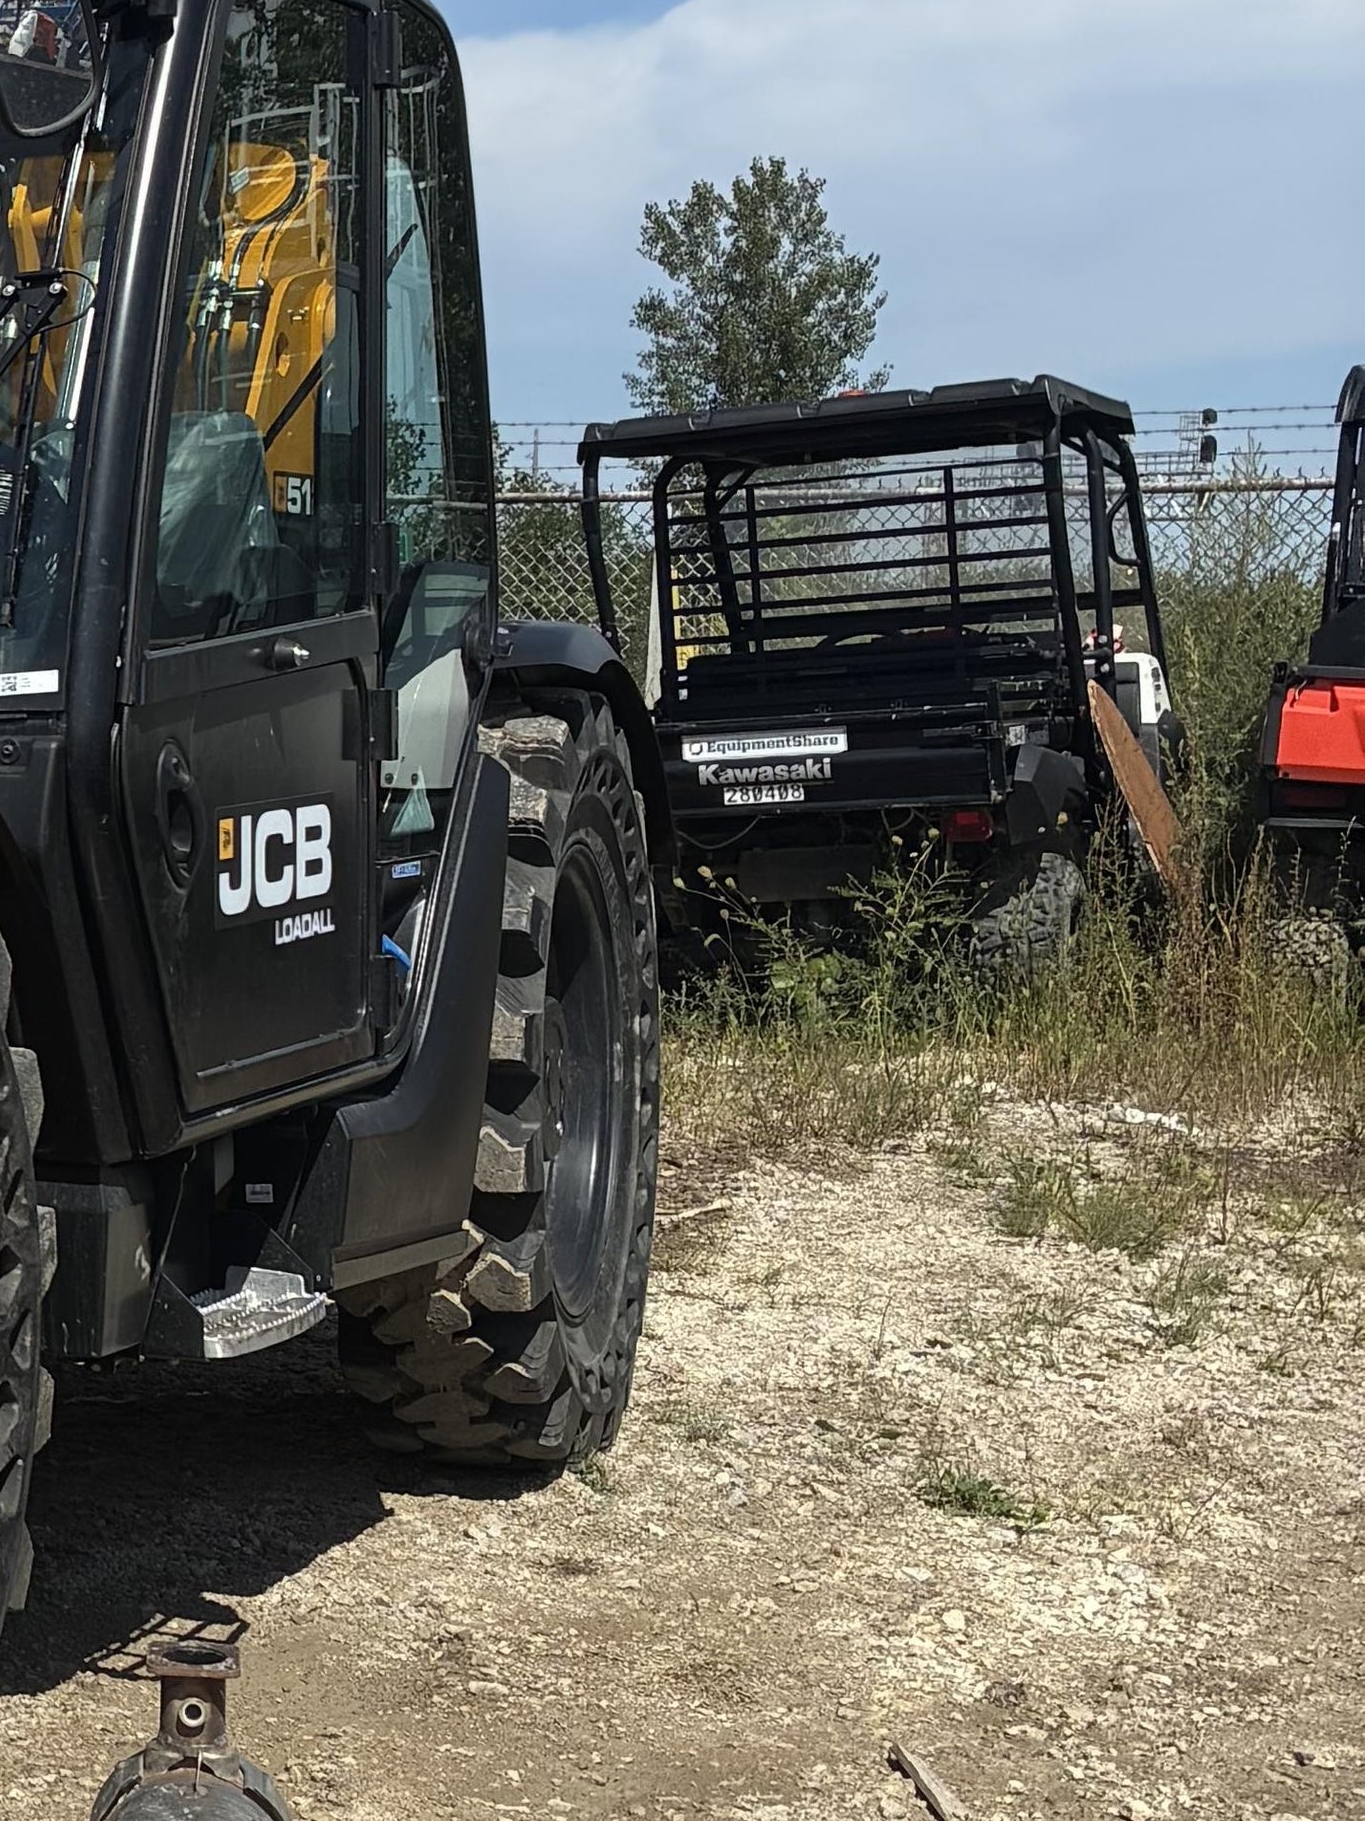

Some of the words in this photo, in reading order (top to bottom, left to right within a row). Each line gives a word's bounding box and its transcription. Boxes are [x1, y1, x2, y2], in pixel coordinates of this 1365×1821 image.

[707, 735, 838, 754] EquipmentShare
[698, 758, 832, 785] Kawasaki
[727, 784, 802, 803] 280408
[219, 804, 332, 915] JCB
[275, 908, 335, 945] LOADALL
